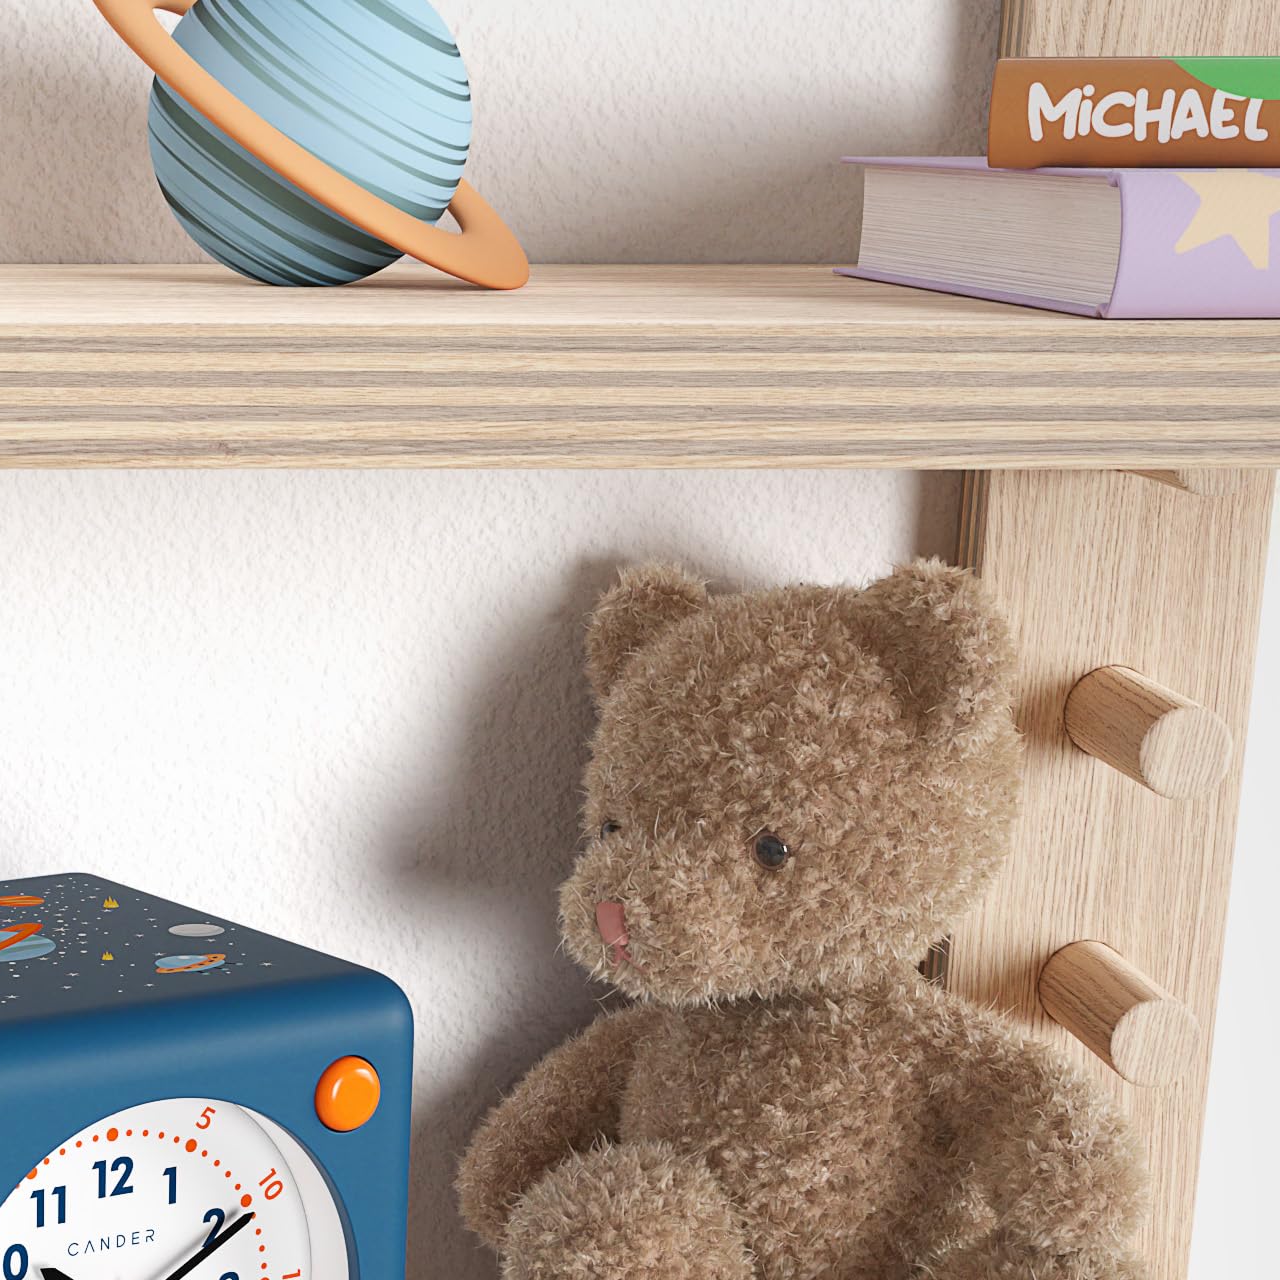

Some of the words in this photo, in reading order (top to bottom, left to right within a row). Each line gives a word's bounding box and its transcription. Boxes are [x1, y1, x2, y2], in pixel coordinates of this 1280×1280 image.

[195, 1106, 216, 1130] 5
[92, 1156, 134, 1199] 12
[162, 1166, 177, 1205] 1
[258, 1167, 284, 1200] 10
[30, 1185, 67, 1228] 11
[67, 1229, 156, 1256] CANDER
[202, 1208, 226, 1250] 2
